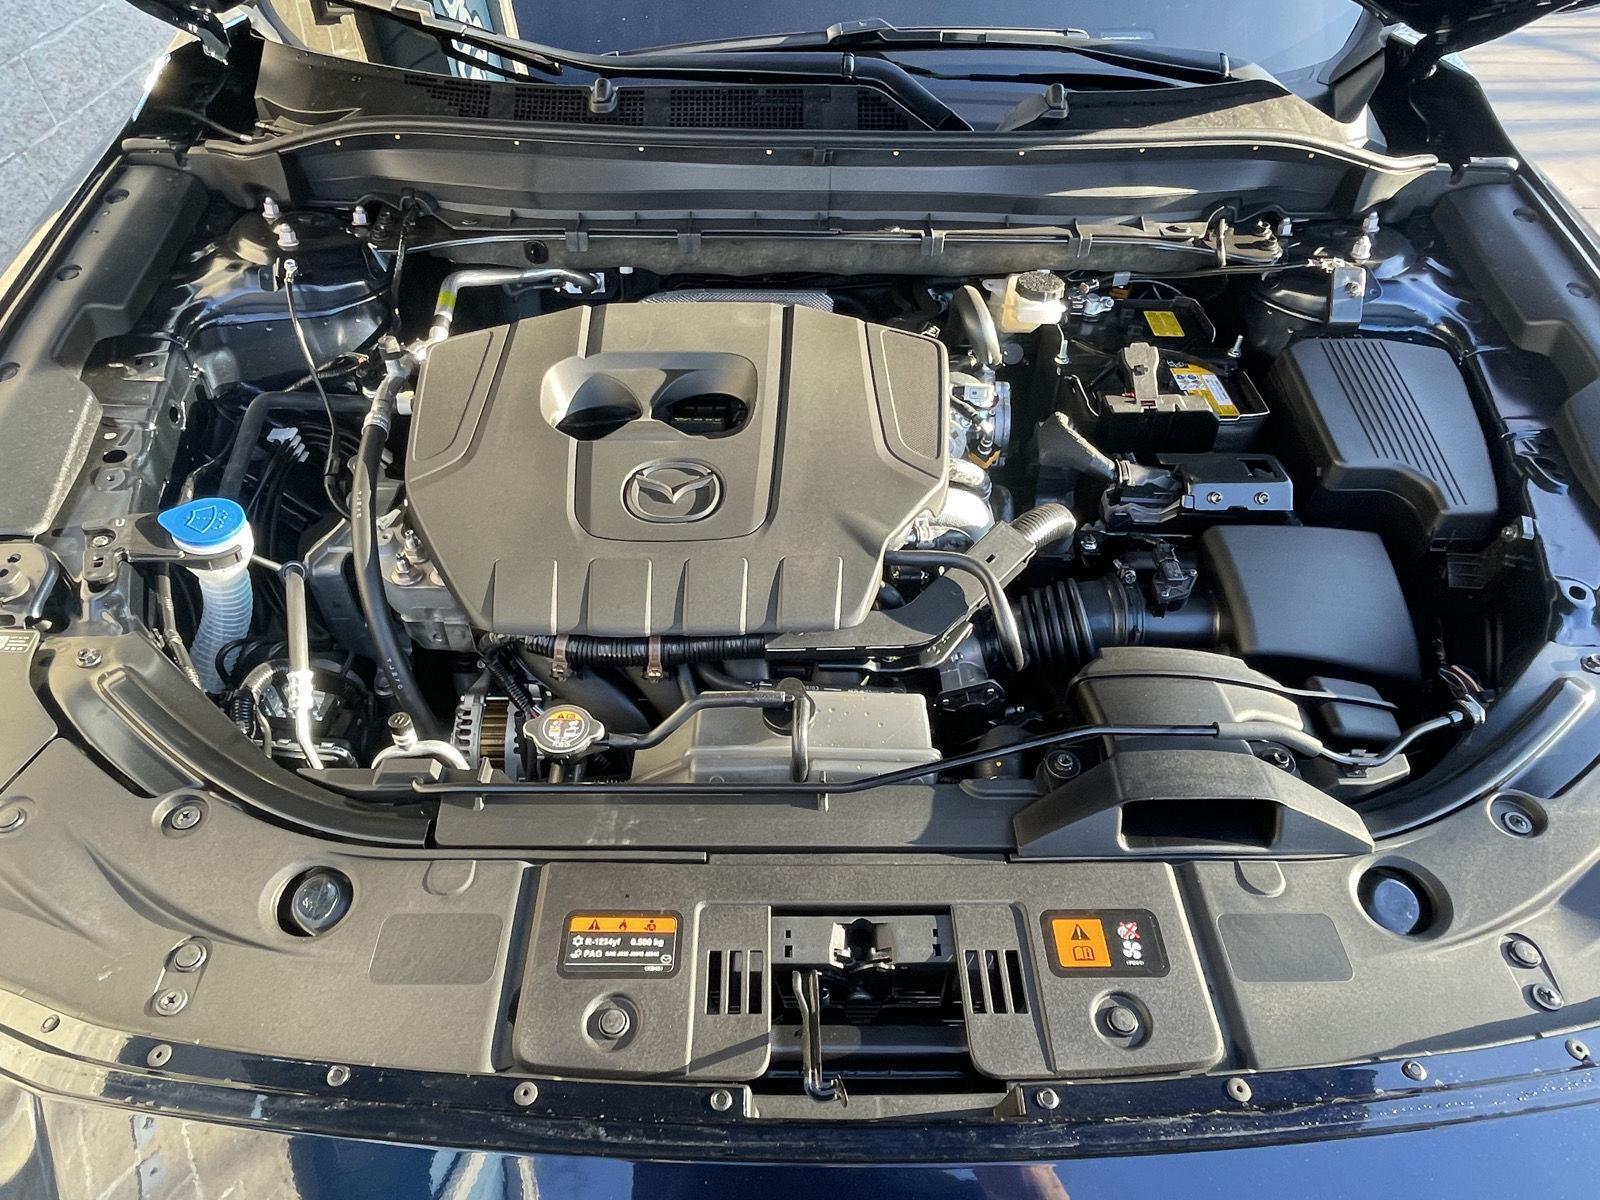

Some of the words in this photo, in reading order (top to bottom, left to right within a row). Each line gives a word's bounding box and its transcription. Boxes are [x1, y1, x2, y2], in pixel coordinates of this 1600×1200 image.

[585, 937, 622, 947] R-1234yf
[653, 938, 664, 947] kg
[584, 949, 602, 957] PAG
